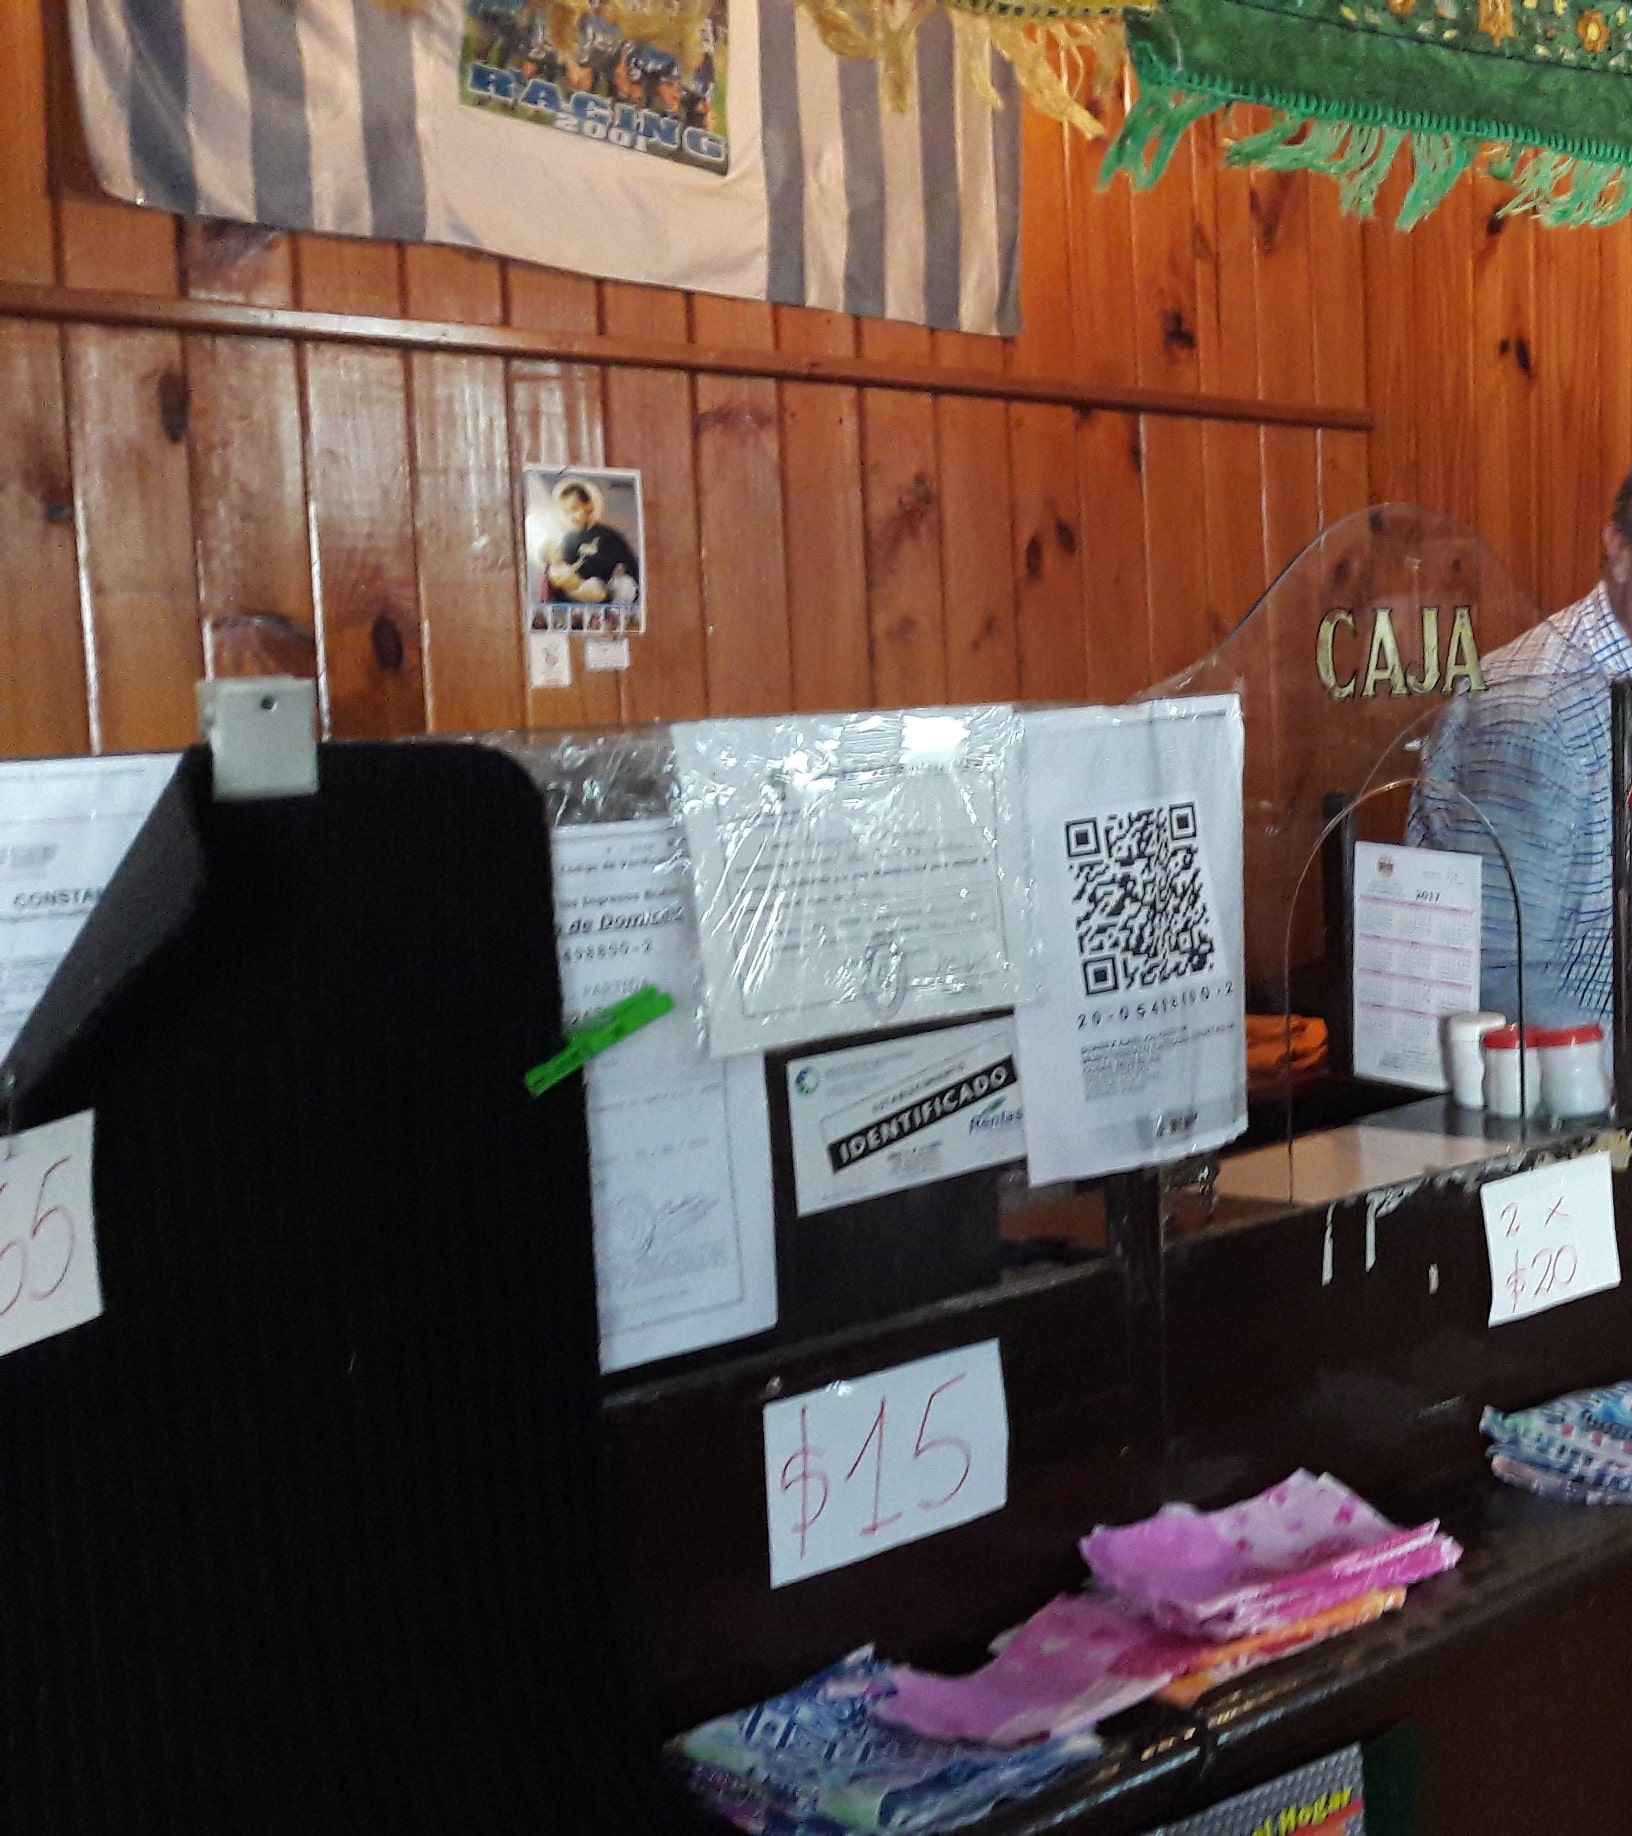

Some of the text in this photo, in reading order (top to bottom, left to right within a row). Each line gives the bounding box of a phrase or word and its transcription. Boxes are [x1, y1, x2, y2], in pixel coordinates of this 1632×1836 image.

[467, 62, 729, 161] RACING
[553, 112, 650, 153] 2001
[1315, 605, 1489, 701] CAJA
[12, 885, 104, 907] CONSTA
[838, 1065, 1008, 1164] IDENTIFICADO
[1500, 1202, 1521, 1239] 2
[1505, 1243, 1578, 1314] $20
[780, 1372, 972, 1559] $15
[1278, 1785, 1354, 1836] Hogar
